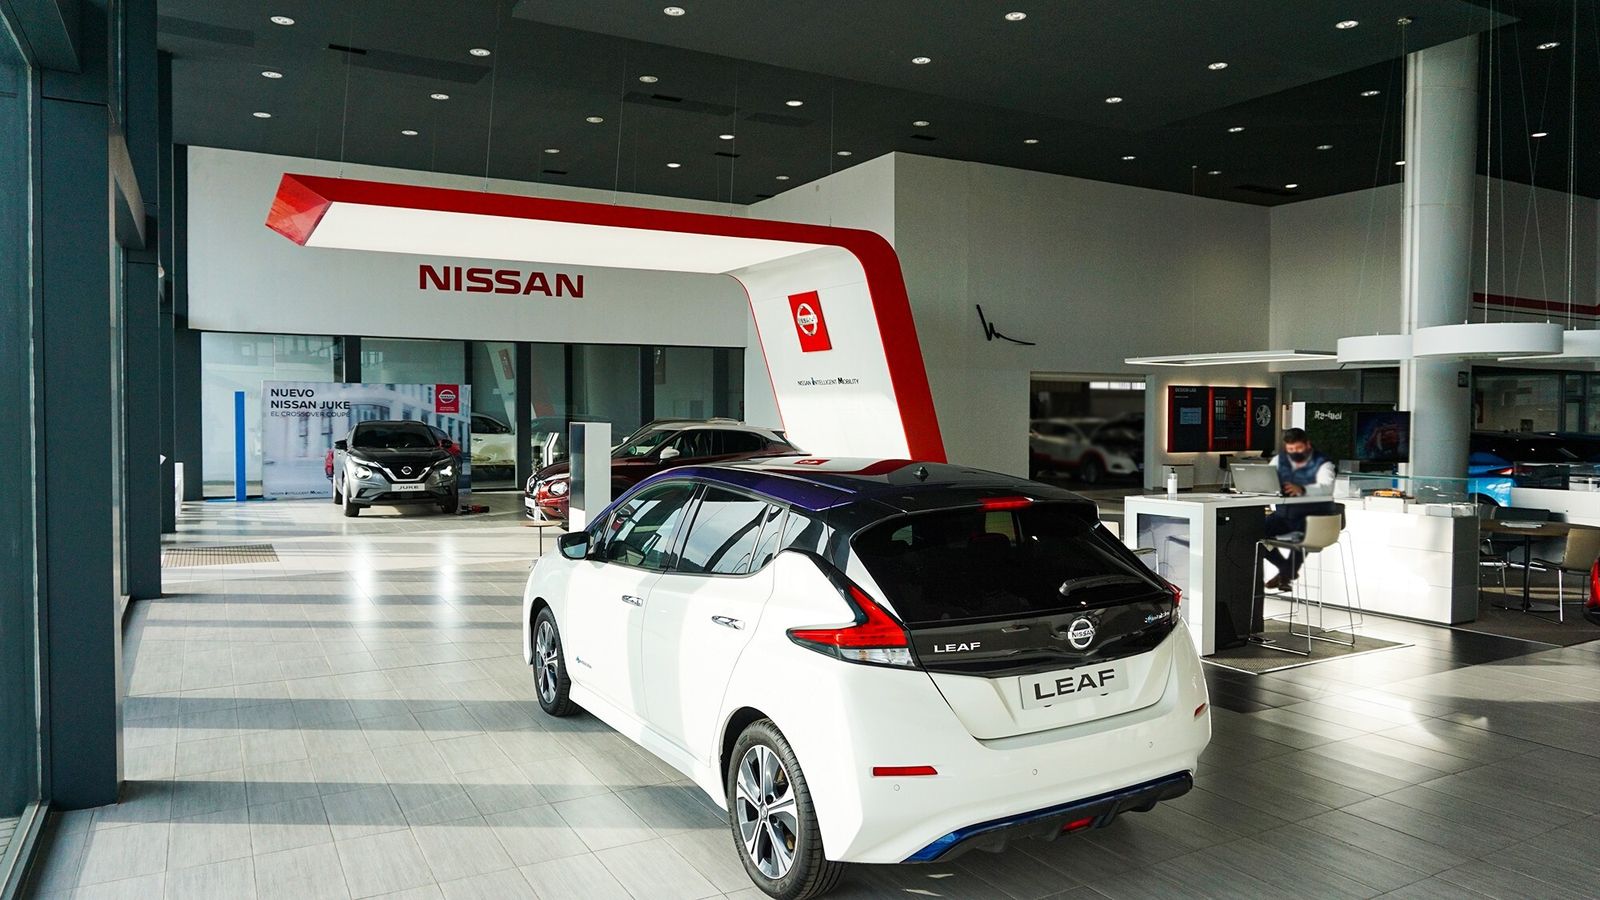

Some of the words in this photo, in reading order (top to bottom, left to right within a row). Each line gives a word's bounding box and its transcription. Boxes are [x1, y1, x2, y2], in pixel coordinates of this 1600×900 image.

[419, 264, 584, 299] NISSAN
[270, 388, 315, 398] NUEVO
[270, 400, 317, 409] NISSAN
[319, 401, 351, 410] JUKE
[1071, 626, 1095, 638] NISSAN
[933, 641, 981, 653] LEAF
[1033, 668, 1115, 700] LEAF
